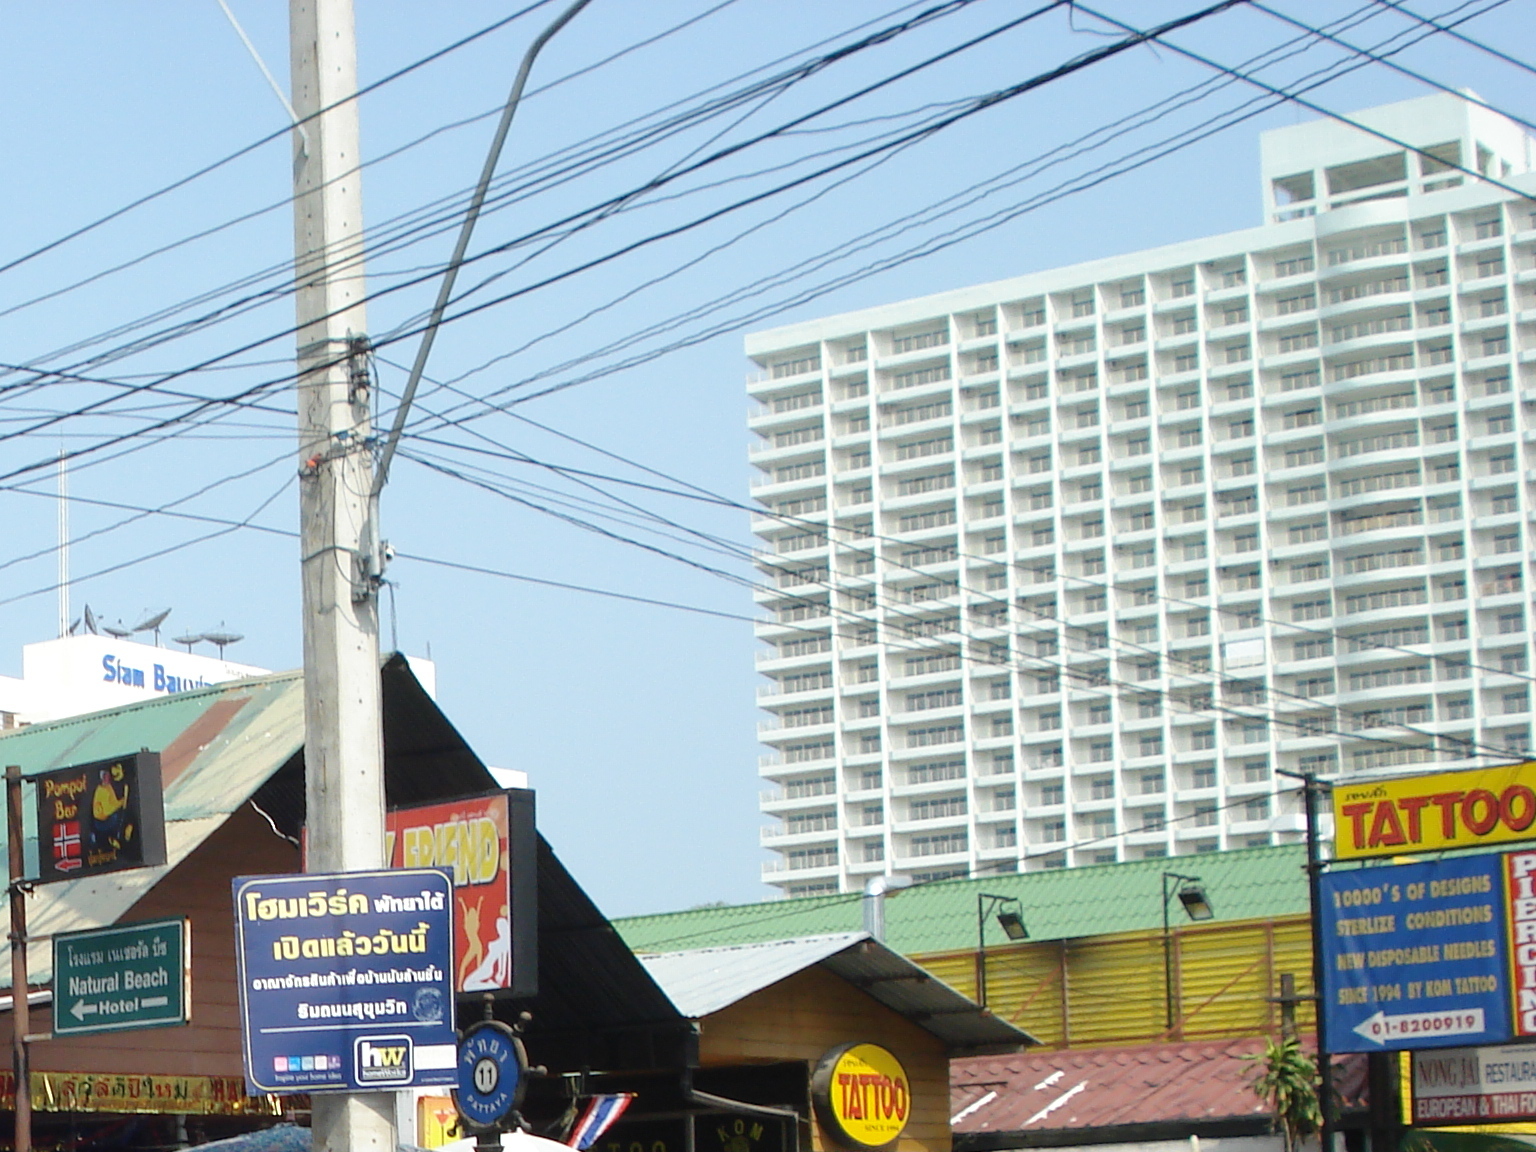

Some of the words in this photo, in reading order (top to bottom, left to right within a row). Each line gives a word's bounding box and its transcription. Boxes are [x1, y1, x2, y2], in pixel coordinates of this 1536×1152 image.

[102, 654, 145, 689] Siam
[153, 664, 214, 695] Bayvi
[55, 800, 78, 820] Bar
[1342, 784, 1536, 850] TATTOO
[1406, 882, 1426, 901] OF
[1430, 874, 1492, 899] DESIGNS
[1406, 904, 1493, 930] CONDITIONS
[272, 921, 431, 961] เปิดแล้ววันนี้
[67, 944, 104, 968] โรงแรม
[1337, 952, 1365, 971] NEW
[1368, 944, 1440, 968] DISPOSABLE
[1443, 939, 1496, 960] NEEDLES
[69, 971, 120, 997] Natural
[124, 966, 168, 991] Beach
[1337, 986, 1368, 1005] SINCE
[1373, 983, 1402, 1002] 1994
[1407, 981, 1422, 999] BY
[1426, 978, 1453, 997] KOM
[1455, 974, 1498, 994] TATTOO
[98, 996, 139, 1016] Hotel
[1371, 1014, 1476, 1036] 01-8200919
[361, 1042, 407, 1067] hw
[464, 1038, 509, 1065] พัทยา
[479, 1066, 493, 1086] 11
[1418, 1058, 1457, 1089] NONG
[466, 1092, 508, 1114] PATTAYA
[837, 1072, 907, 1122] TATTOO
[1417, 1097, 1477, 1118] EUROPEAN
[1479, 1095, 1490, 1117] &
[1493, 1093, 1519, 1116] THAI
